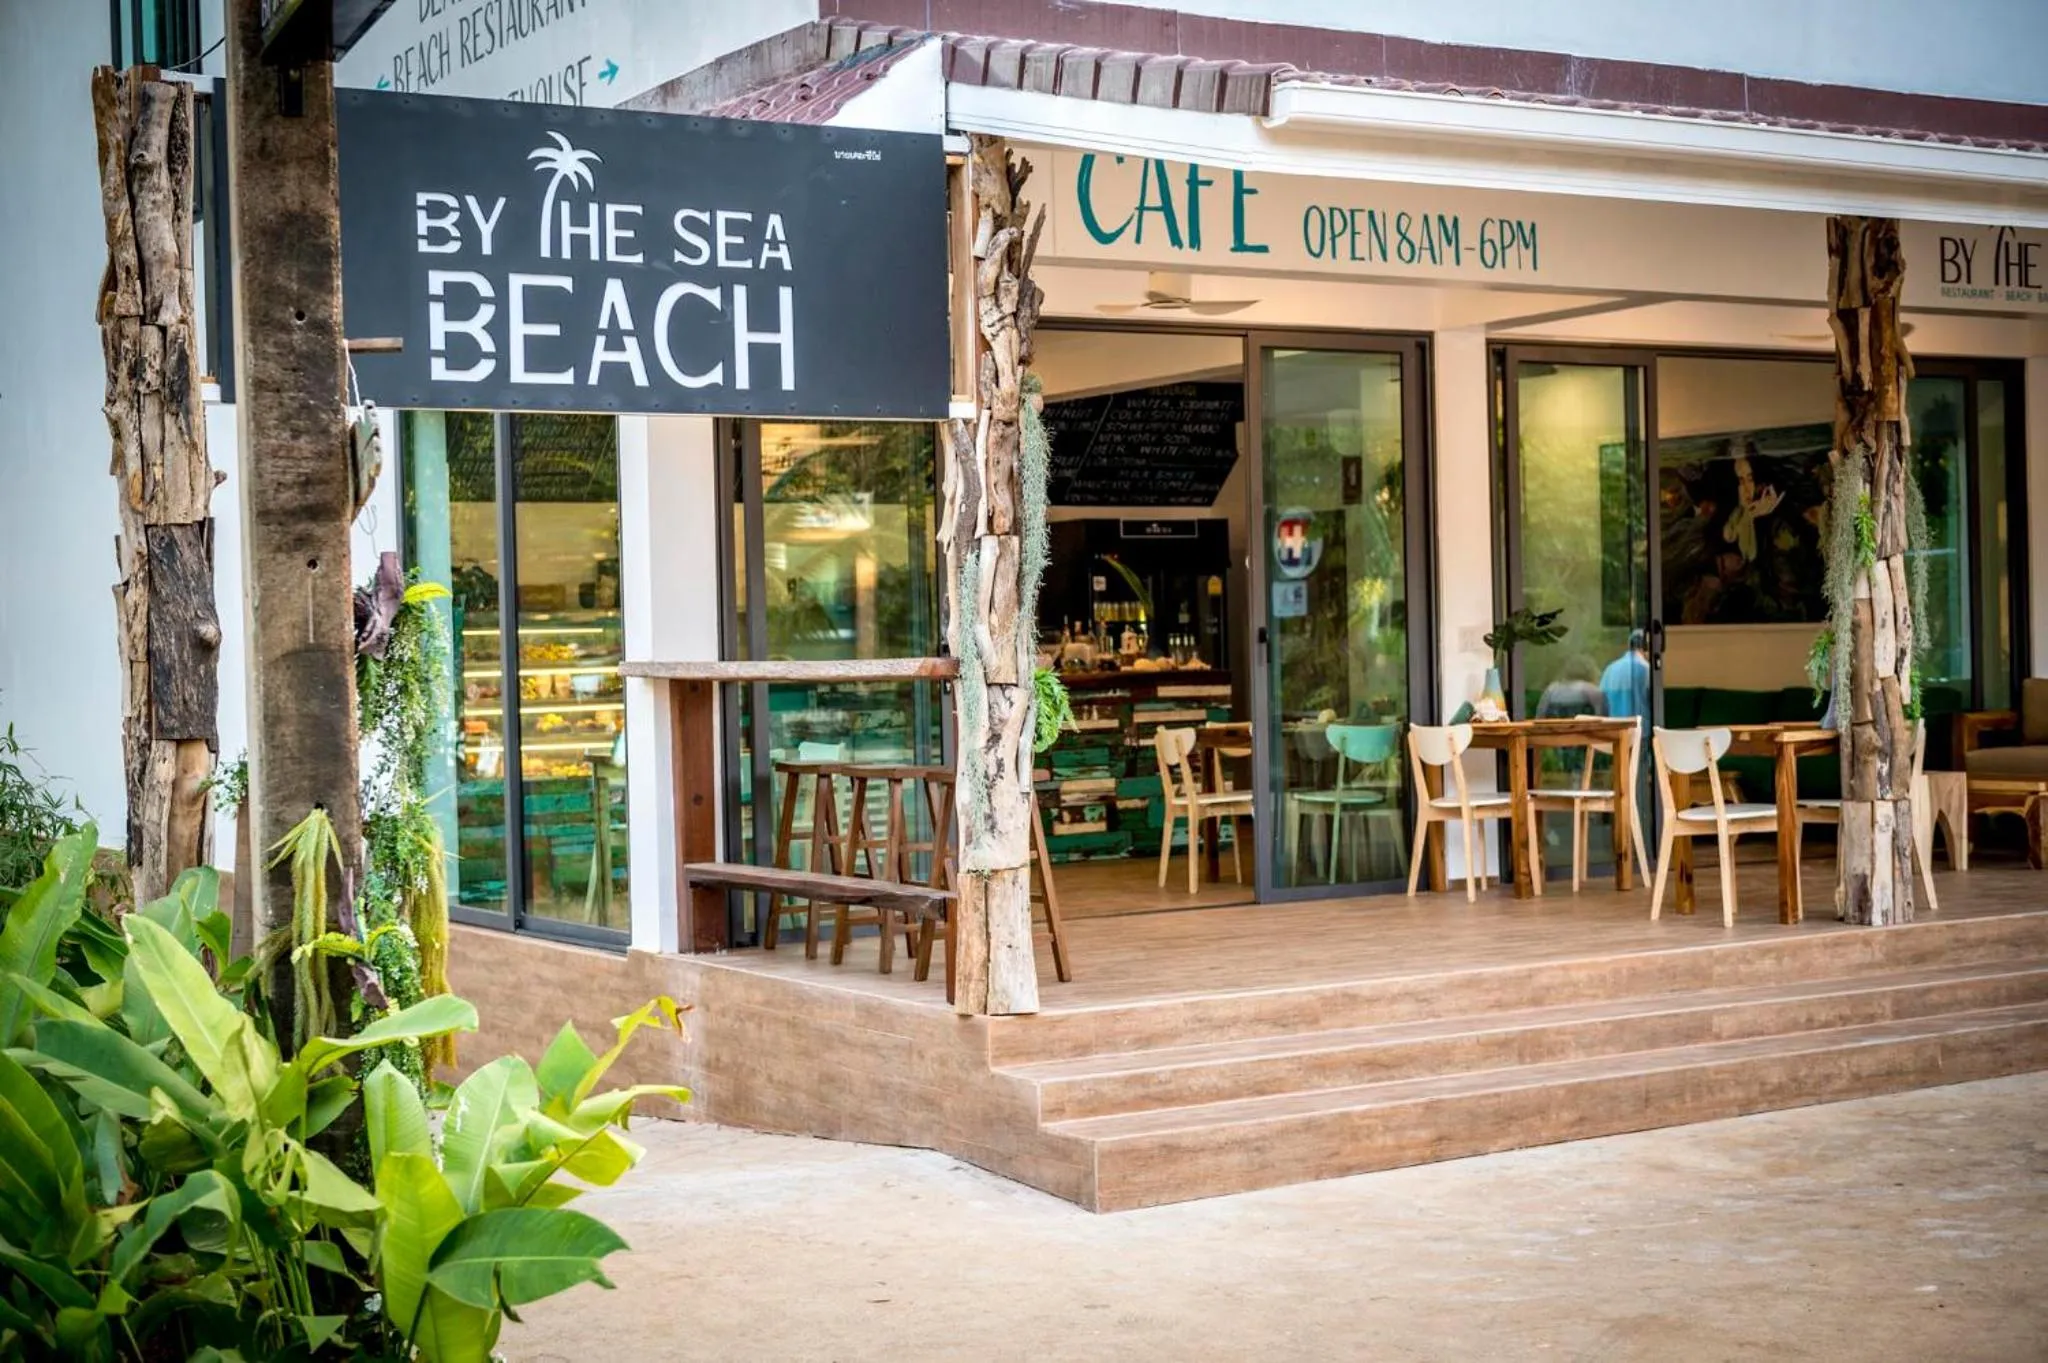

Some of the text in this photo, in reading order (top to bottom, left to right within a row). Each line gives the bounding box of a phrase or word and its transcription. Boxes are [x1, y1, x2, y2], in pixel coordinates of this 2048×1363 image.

[393, 27, 451, 93] BEACH
[416, 192, 507, 255] BY
[673, 208, 793, 271] SEA
[1077, 153, 1270, 253] CAFE
[1303, 204, 1388, 263] OPEN
[1940, 236, 1978, 285] BY
[428, 269, 796, 391] BEACH
